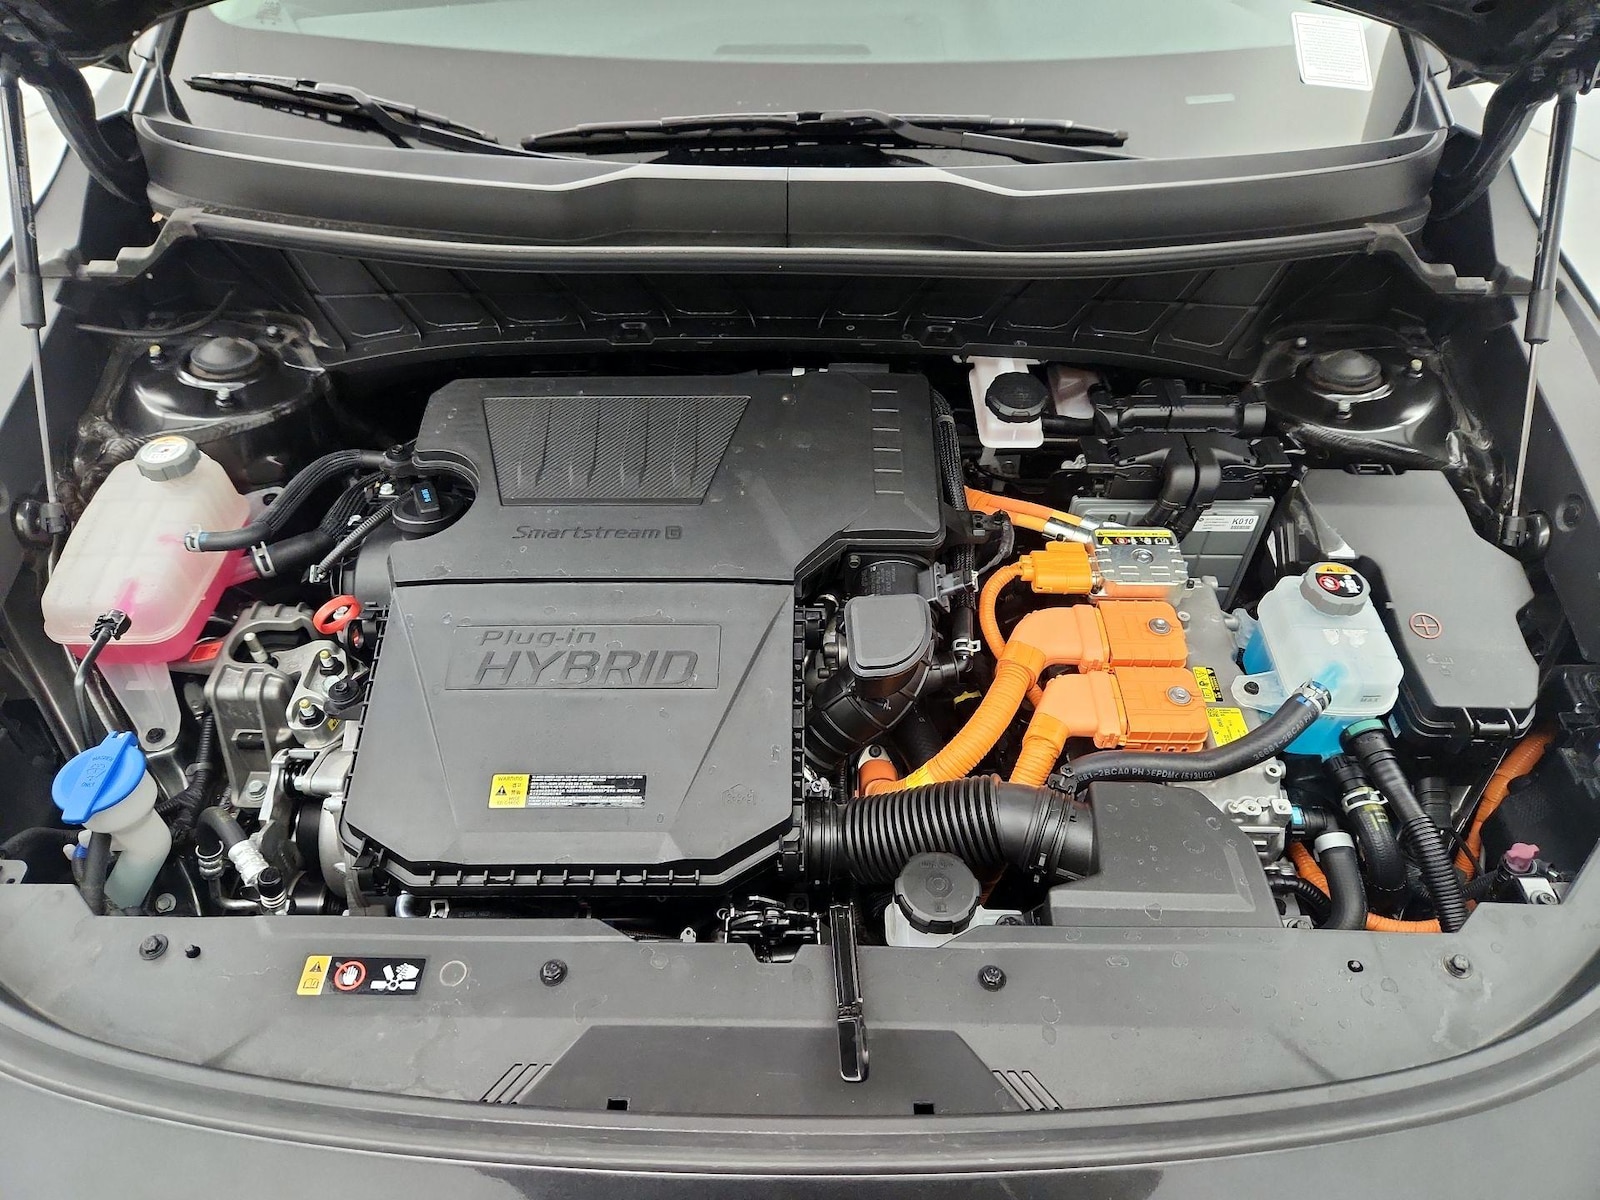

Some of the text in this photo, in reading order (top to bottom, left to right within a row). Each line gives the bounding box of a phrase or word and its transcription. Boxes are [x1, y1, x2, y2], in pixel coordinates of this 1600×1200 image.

[512, 525, 661, 539] Smartstream
[479, 628, 597, 647] Plug-in
[473, 649, 699, 685] HYBRID
